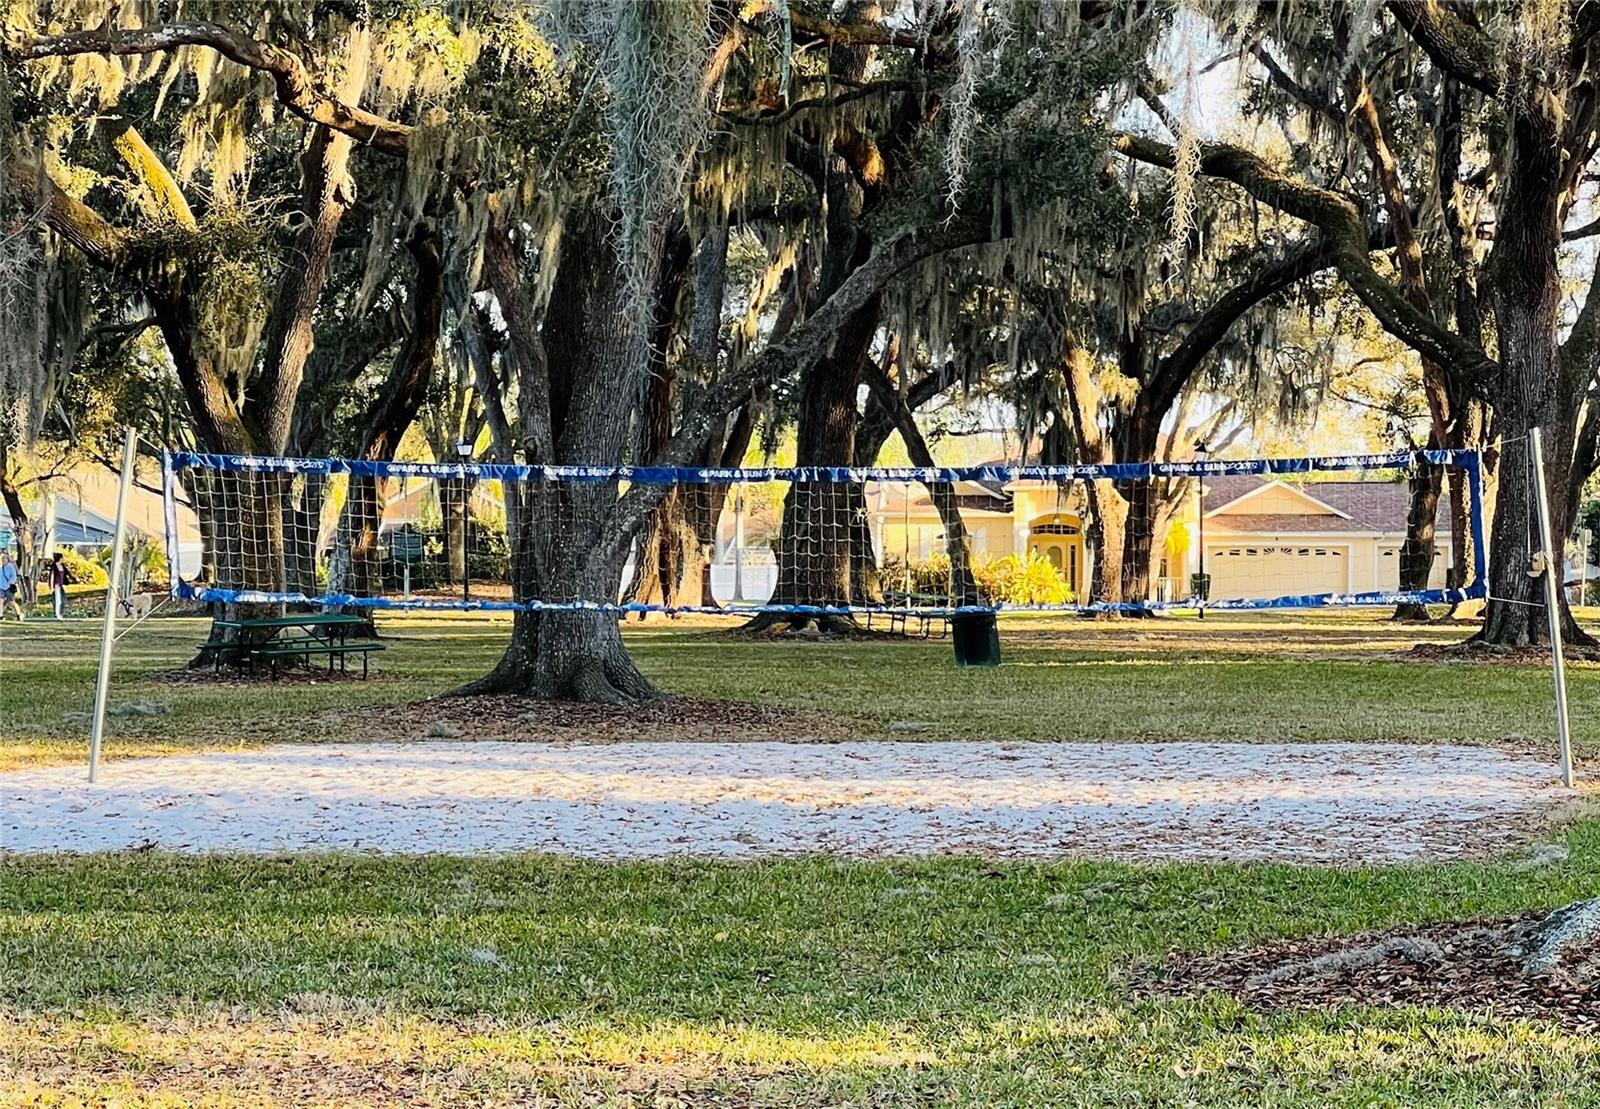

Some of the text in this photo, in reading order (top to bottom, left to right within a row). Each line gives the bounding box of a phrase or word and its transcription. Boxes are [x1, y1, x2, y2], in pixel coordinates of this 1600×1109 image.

[1368, 456, 1387, 464] SUN
[430, 465, 449, 473] SUN
[579, 468, 586, 476] &
[587, 467, 605, 476] SUN
[1016, 467, 1037, 475] ARK
[1048, 467, 1067, 475] SUN
[1171, 464, 1194, 472] PARK
[1204, 463, 1222, 471] SUN
[709, 469, 732, 477] PARK
[734, 469, 741, 477] &
[742, 470, 762, 478] SUN
